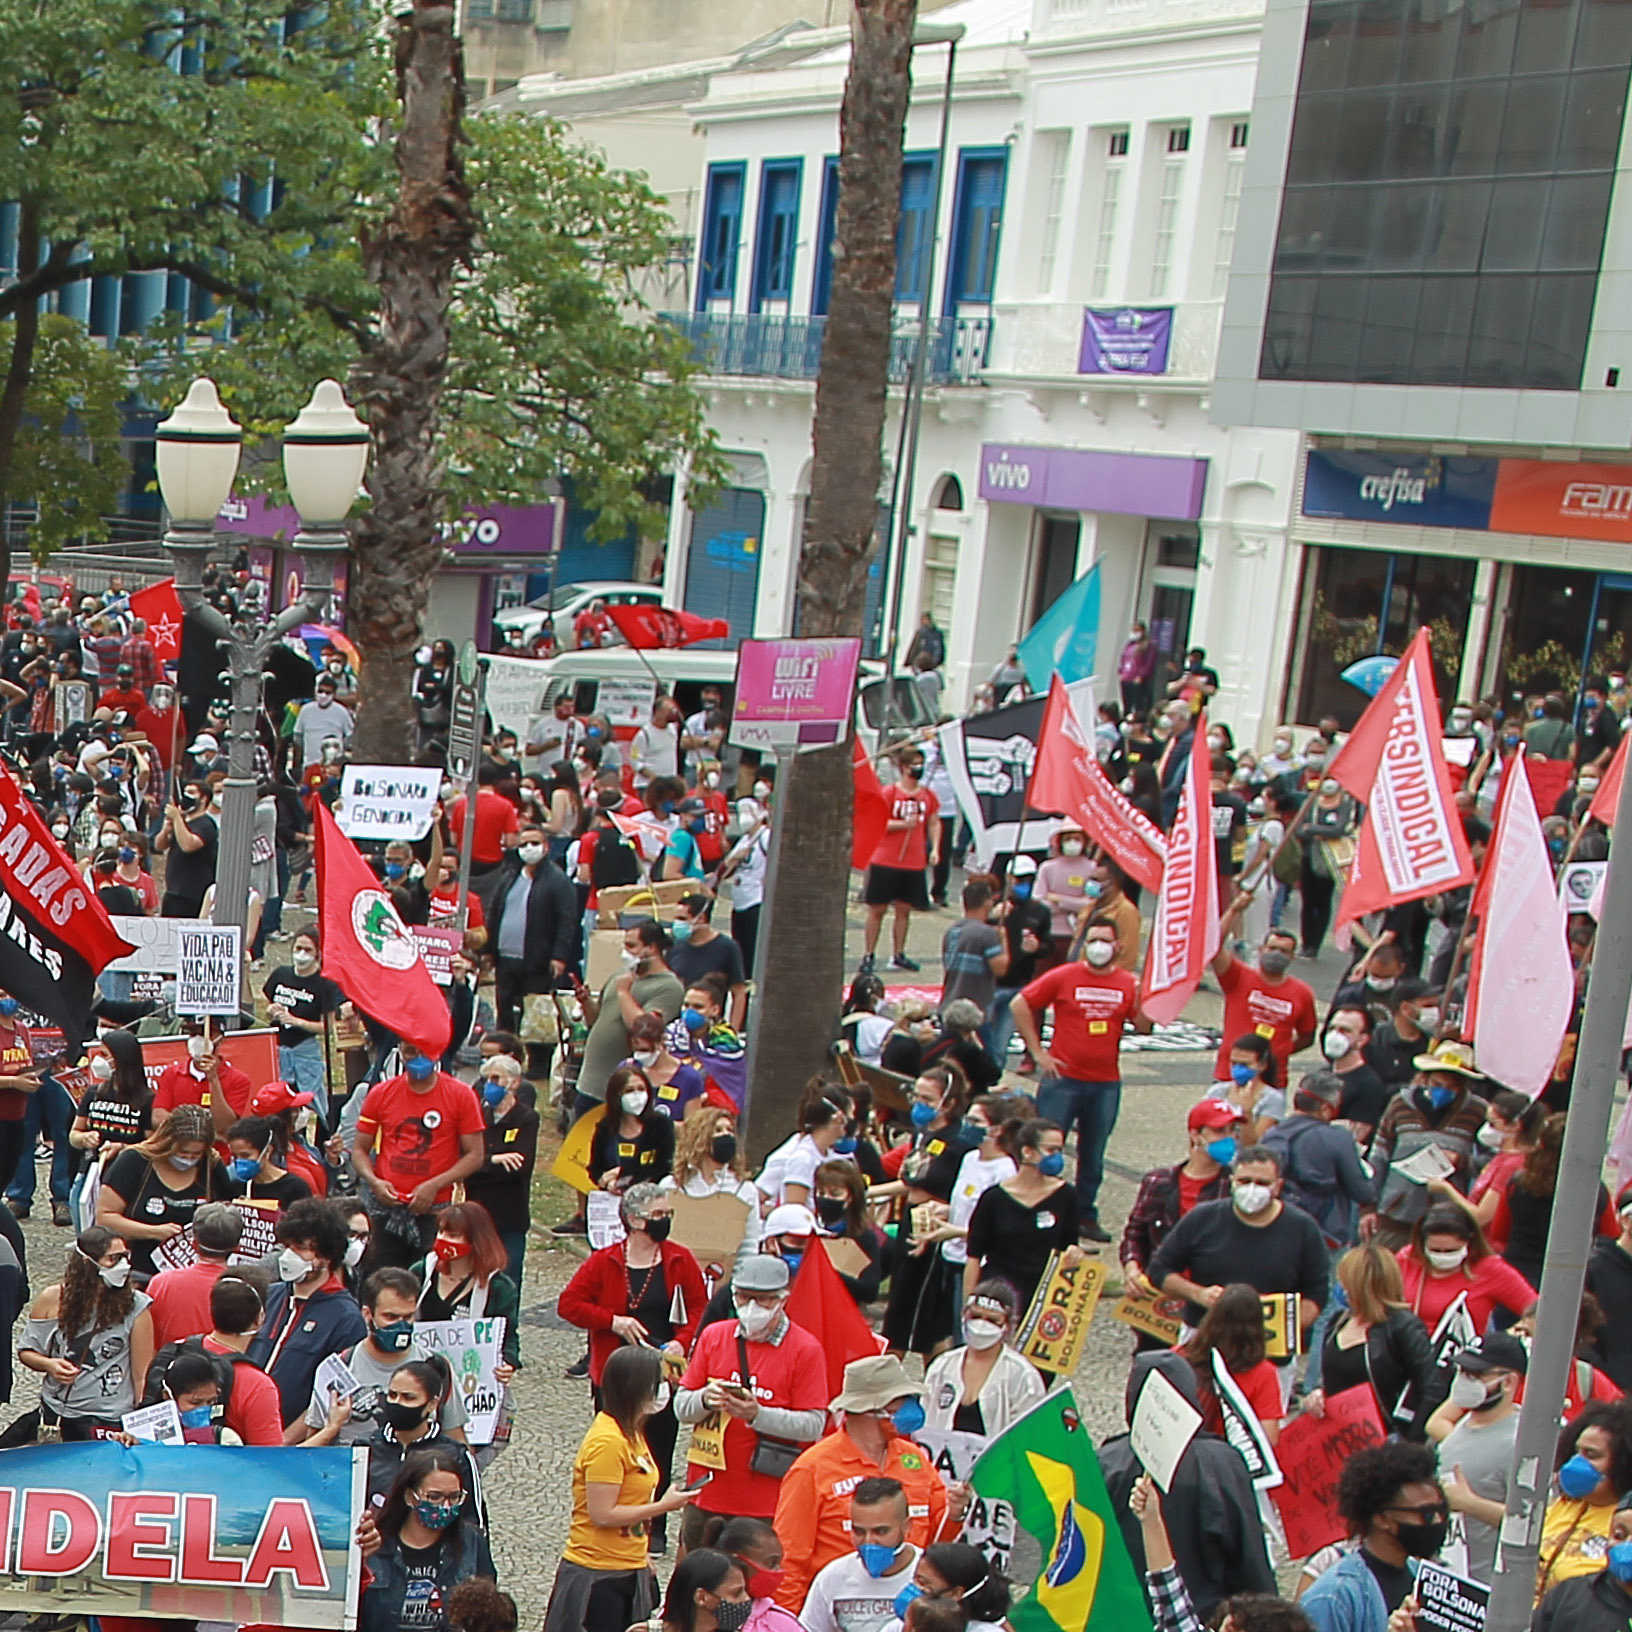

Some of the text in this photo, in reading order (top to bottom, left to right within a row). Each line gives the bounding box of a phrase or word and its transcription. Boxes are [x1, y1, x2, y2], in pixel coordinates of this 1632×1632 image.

[986, 453, 1030, 490] vivo
[1360, 468, 1427, 511] crefisa
[771, 682, 816, 700] LIVRE
[352, 779, 429, 799] BOLSONARO
[351, 803, 413, 826] GENOCIDA
[180, 960, 235, 983] VACINA &
[1058, 1267, 1100, 1371] BOLSONARO
[448, 1326, 465, 1348] DE
[465, 1386, 497, 1414] CHÃO
[1420, 1567, 1457, 1590] FORA
